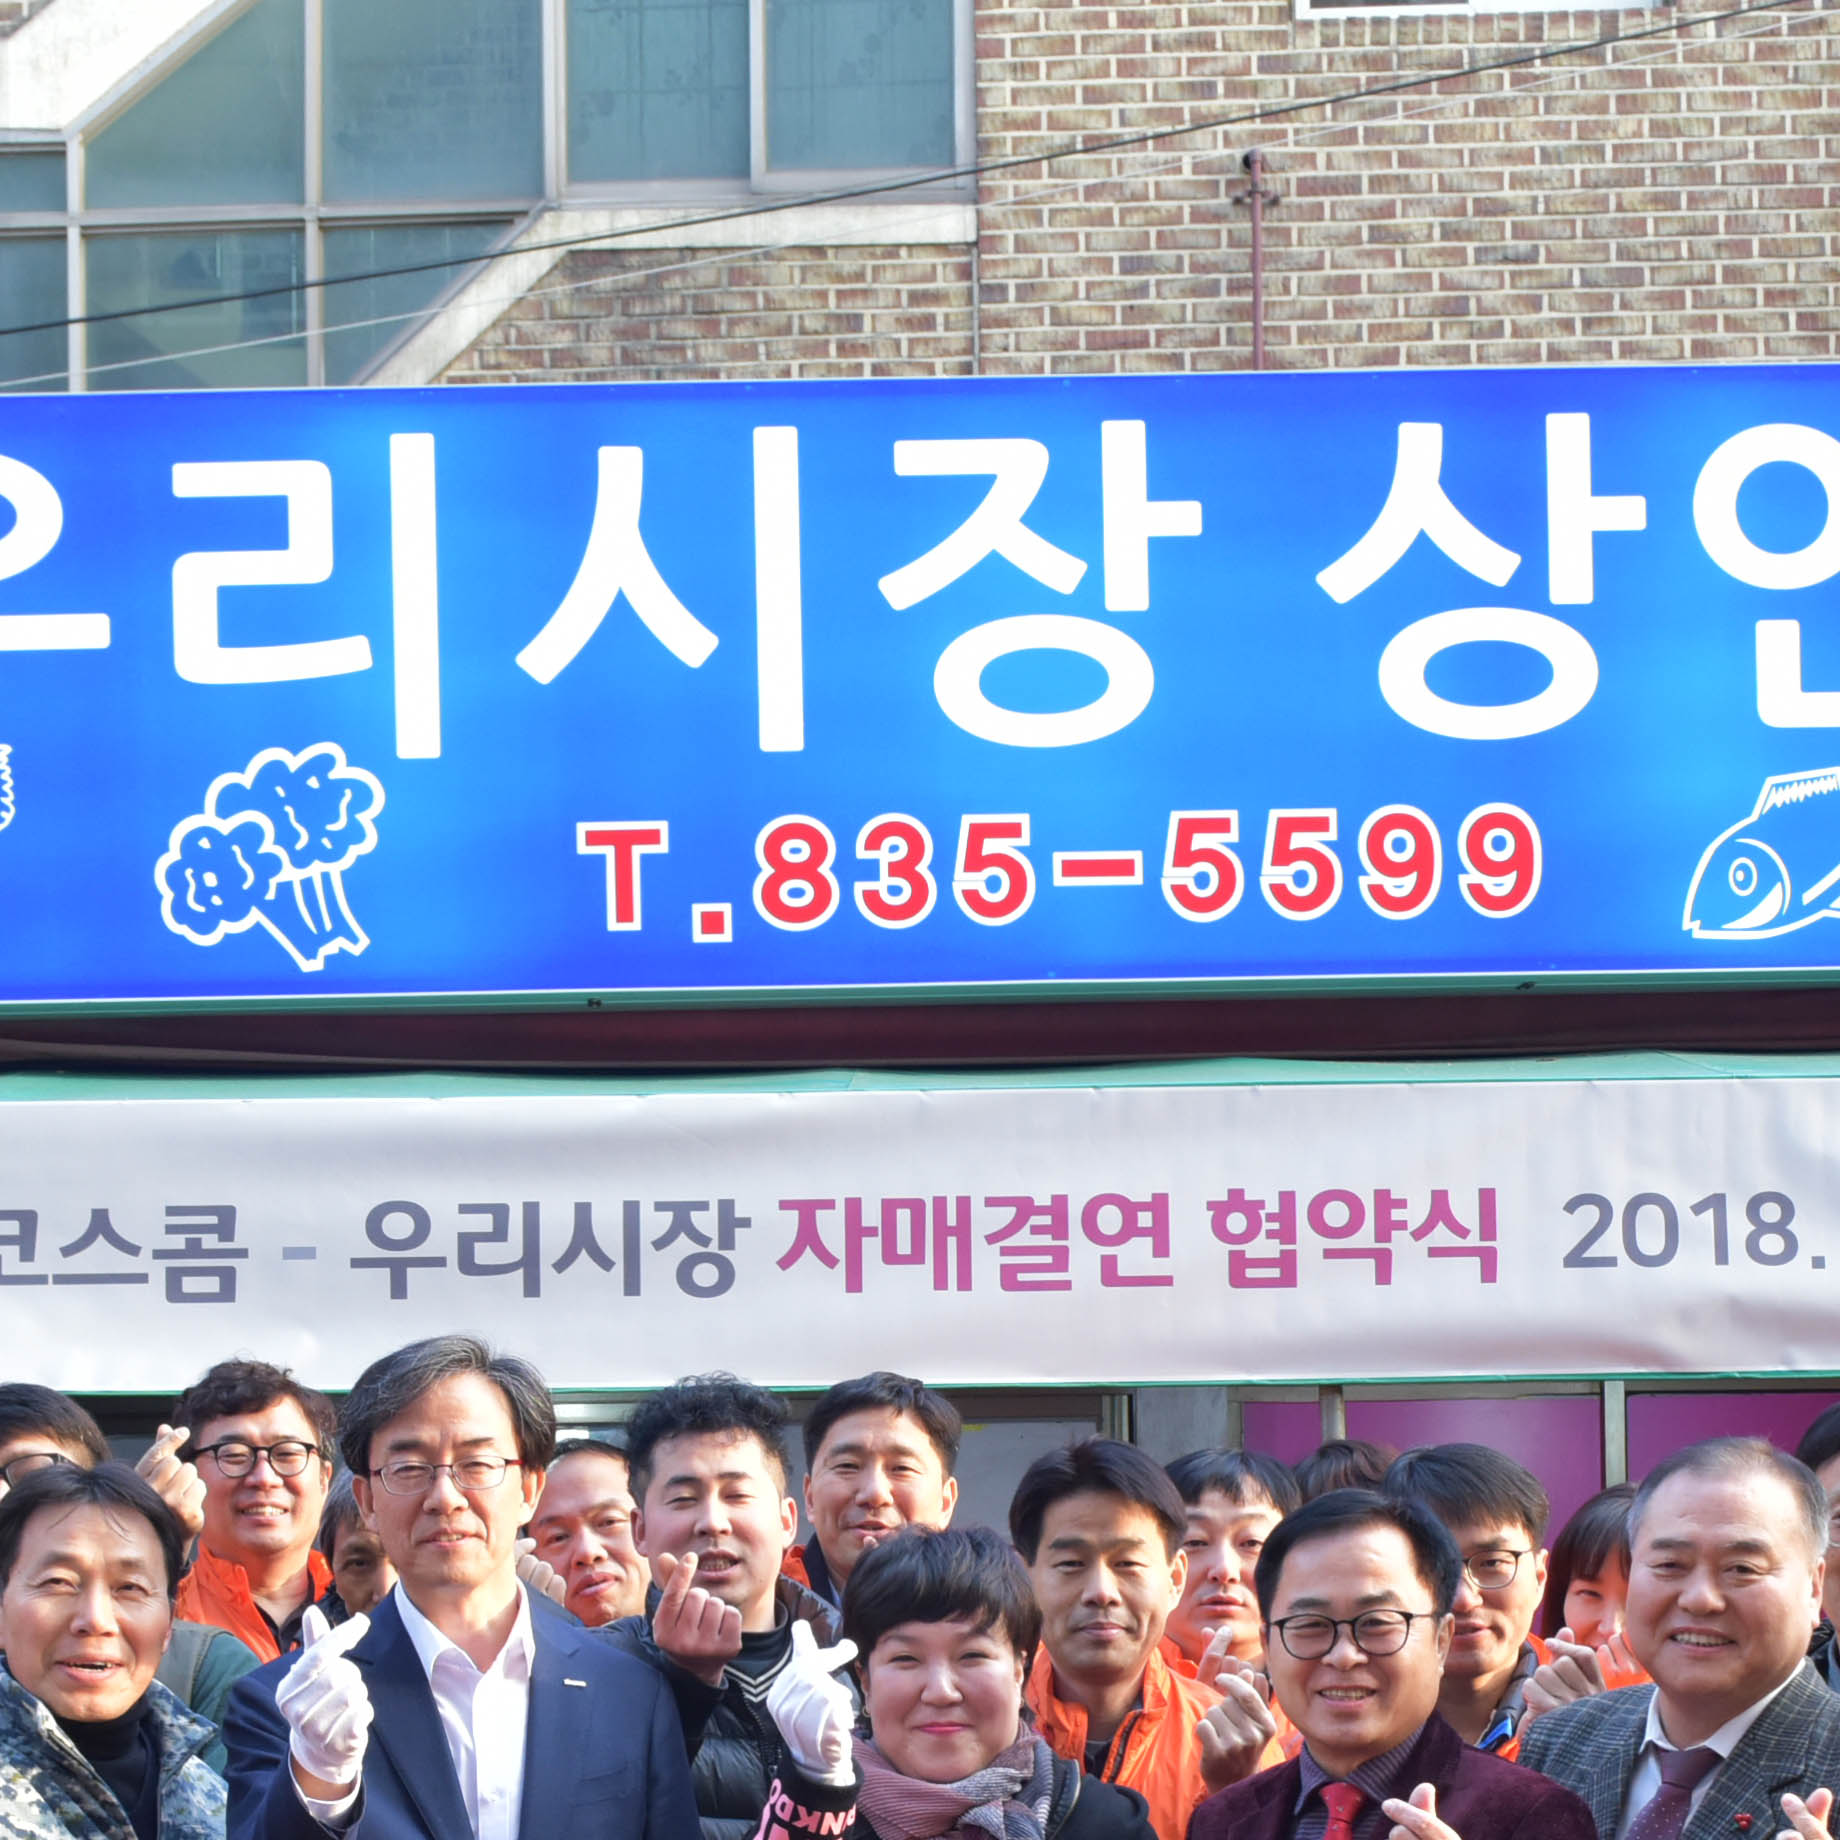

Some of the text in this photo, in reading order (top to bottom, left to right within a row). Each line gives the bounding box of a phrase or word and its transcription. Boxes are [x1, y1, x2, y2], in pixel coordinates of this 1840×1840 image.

[576, 803, 1543, 943] T.835-5599
[349, 1198, 752, 1300] 우리시장
[775, 1192, 1174, 1293] 자매결연
[1205, 1187, 1498, 1290] 협약식
